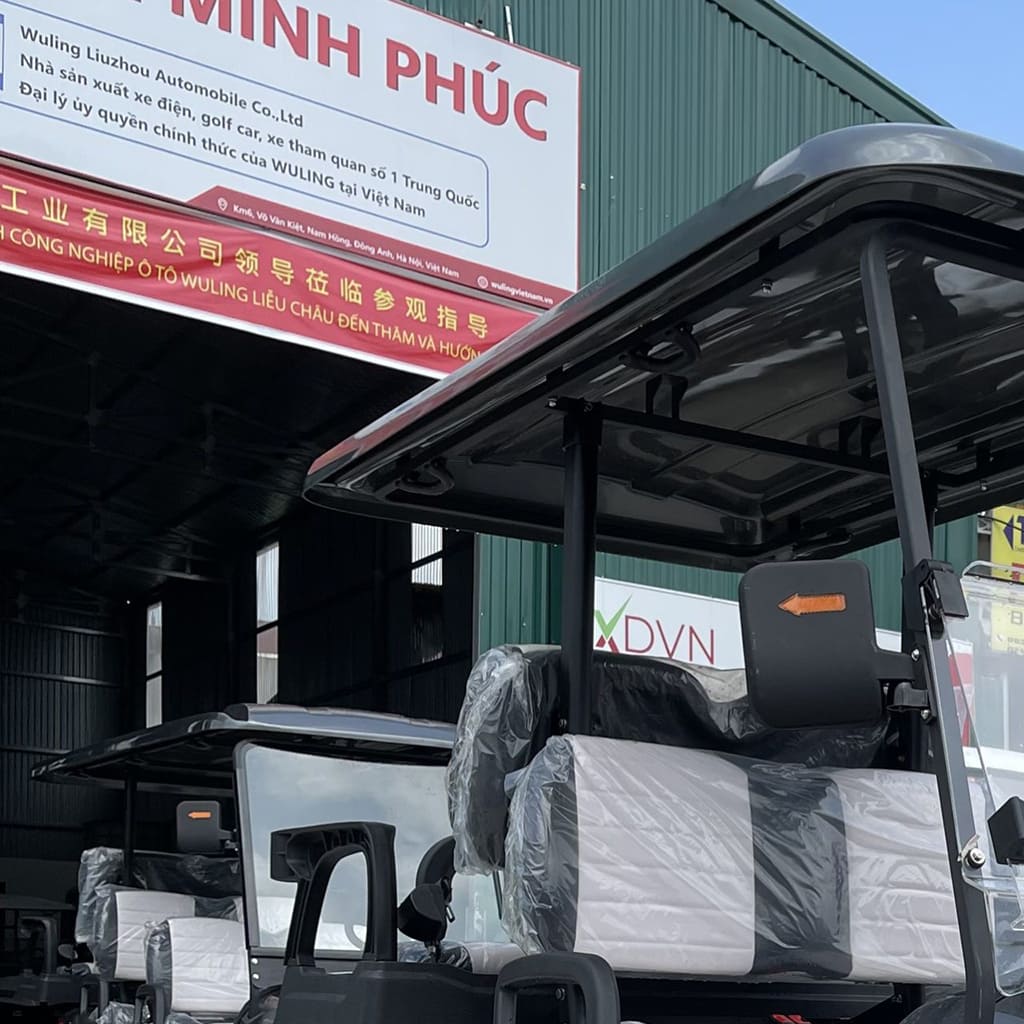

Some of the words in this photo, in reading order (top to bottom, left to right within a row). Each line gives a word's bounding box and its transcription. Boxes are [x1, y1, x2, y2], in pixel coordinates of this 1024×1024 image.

[20, 25, 80, 59] Wuling
[87, 46, 150, 78] Liuzhou
[155, 69, 247, 109] Automobile
[251, 100, 303, 127] Co.,Ltd
[20, 53, 54, 75] Nhà
[60, 67, 87, 86] sản
[93, 79, 129, 99] xuất
[134, 91, 152, 106] xe
[157, 96, 196, 121] điện,
[201, 112, 233, 131] golf
[237, 123, 263, 142] car,
[267, 133, 284, 147] xe
[289, 138, 326, 161] tham
[331, 153, 366, 174] quan
[371, 164, 386, 180] số
[391, 171, 397, 184] 1
[403, 174, 442, 201] Trung
[446, 188, 480, 210] Quốc
[386, 36, 548, 142] PHÚC
[19, 81, 47, 102] Đại
[53, 91, 67, 109] lý
[73, 97, 92, 117] ủy
[98, 107, 148, 132] quyền
[153, 123, 196, 146] chính
[201, 138, 237, 159] thức
[241, 151, 267, 168] của
[271, 158, 335, 189] WULING
[339, 180, 357, 196] tại
[361, 185, 390, 206] Việt
[394, 197, 426, 218] Nam
[10, 225, 64, 255] CÔNG
[69, 242, 134, 274] NGHIỆP
[138, 259, 152, 278] Ô
[155, 264, 177, 284] TÔ
[181, 272, 248, 302] WULING
[290, 300, 334, 325] CHÂU
[338, 313, 369, 334] ĐẾN
[418, 334, 435, 352] VÀ
[307, 226, 326, 239] Nam
[396, 253, 407, 264] Hà
[442, 267, 459, 278] Nam
